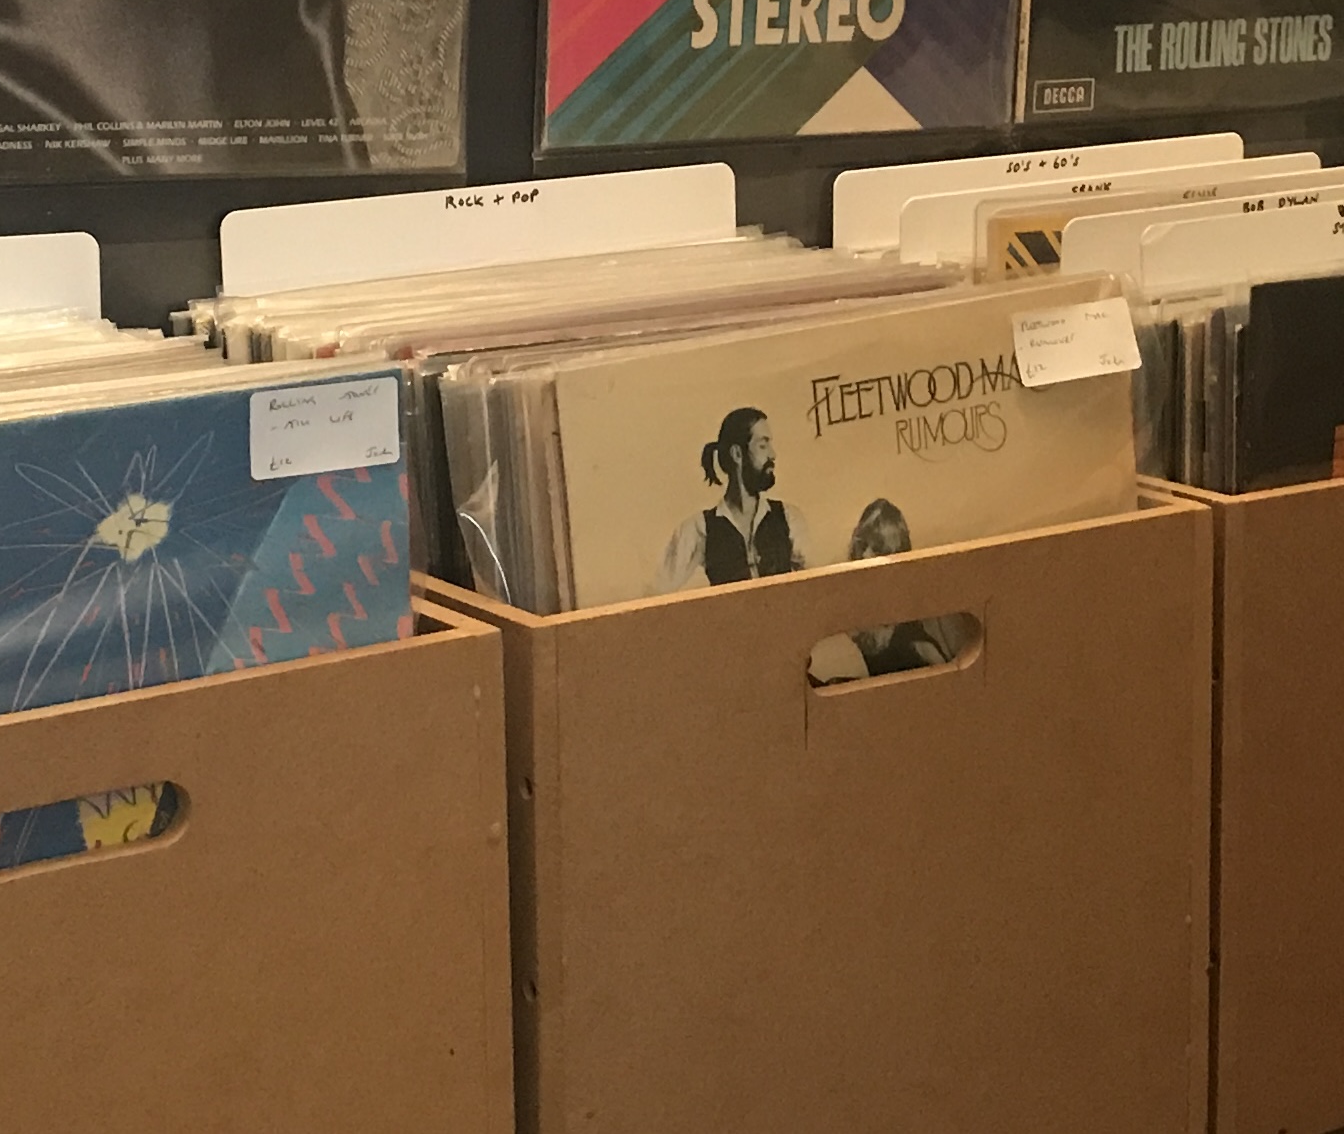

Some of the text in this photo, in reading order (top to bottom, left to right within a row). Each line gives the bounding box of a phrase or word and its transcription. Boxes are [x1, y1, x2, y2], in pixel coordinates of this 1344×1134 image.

[1114, 14, 1335, 74] THE ROLLING STONES
[1043, 85, 1086, 106] DECCA
[122, 154, 144, 165] PLUS
[1242, 193, 1320, 214] BOB DYLAN
[807, 360, 974, 439] FLEETWOOD
[894, 400, 1008, 460] RUMOURS
